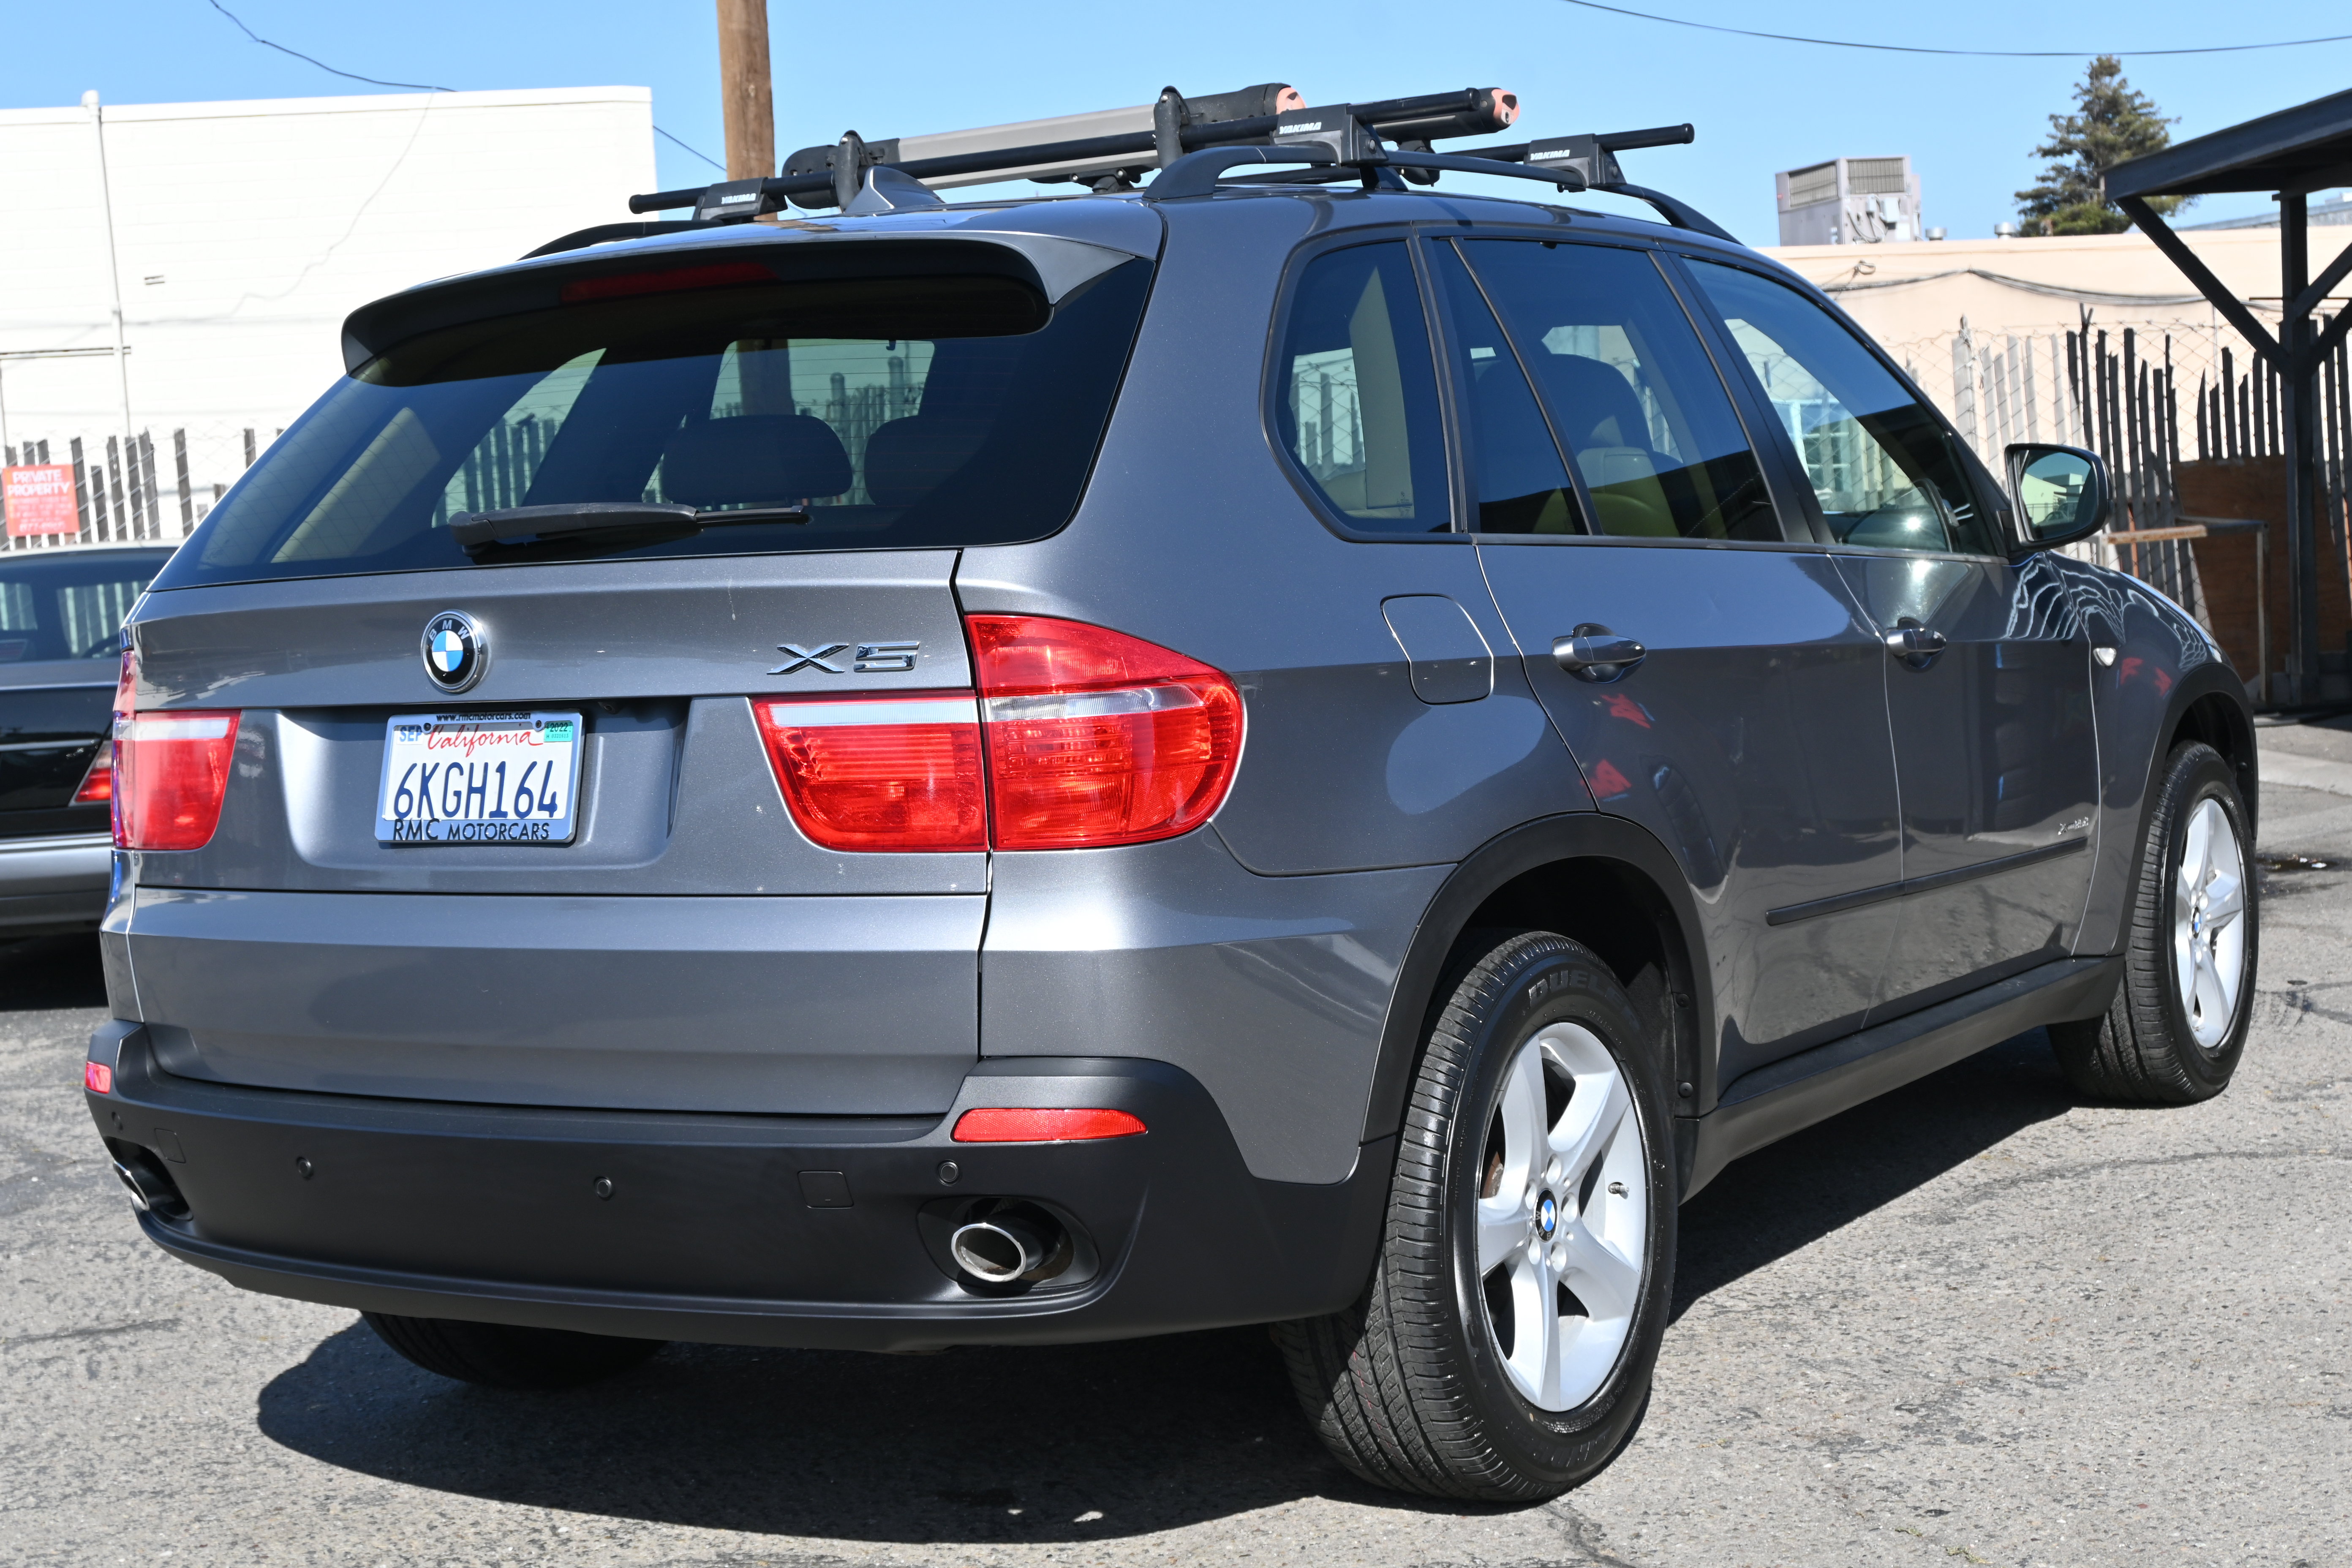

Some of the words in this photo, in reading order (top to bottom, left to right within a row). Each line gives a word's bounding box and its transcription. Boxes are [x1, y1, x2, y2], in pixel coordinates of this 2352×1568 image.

[1279, 122, 1322, 134] YAKIMA
[1530, 149, 1570, 161] YAKIMA
[721, 193, 757, 204] YAKIMA
[12, 469, 62, 484] PRIVATE
[7, 482, 70, 497] PROPERTY
[428, 620, 470, 641] BMW
[766, 641, 920, 675] X5
[436, 712, 531, 722] www.rmcmotorcars.com
[399, 726, 422, 742] SEP
[550, 722, 569, 732] 2022
[427, 723, 544, 758] California
[394, 760, 558, 819] 6KGH164
[393, 818, 441, 840] RMC
[448, 822, 550, 840] MOTORCARS
